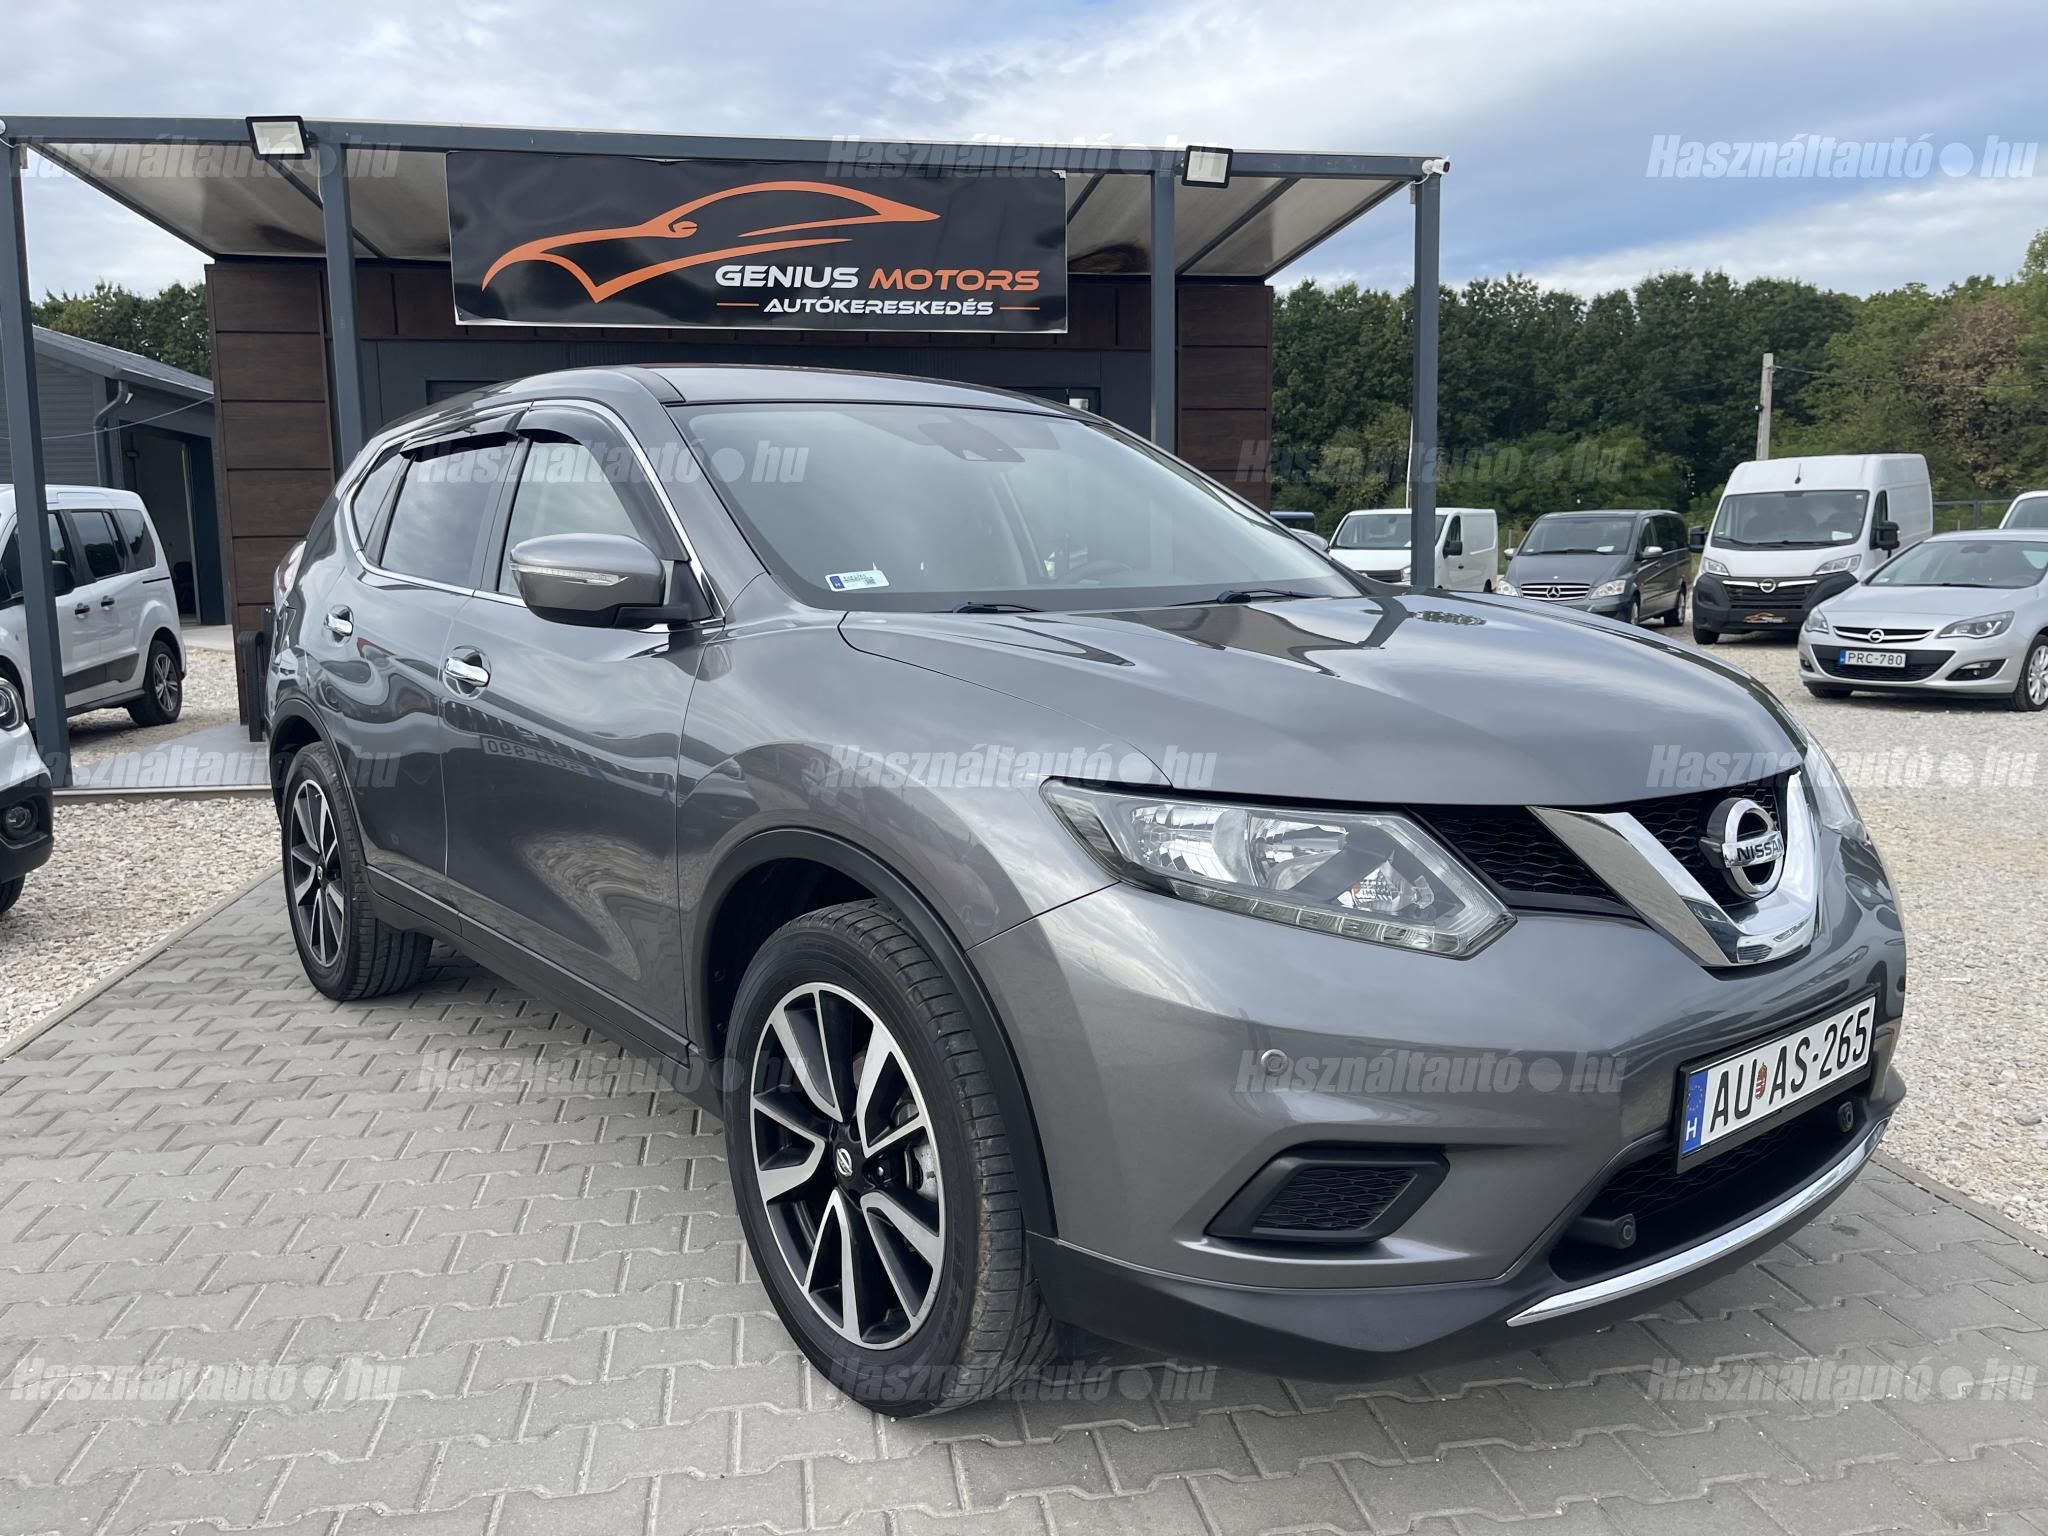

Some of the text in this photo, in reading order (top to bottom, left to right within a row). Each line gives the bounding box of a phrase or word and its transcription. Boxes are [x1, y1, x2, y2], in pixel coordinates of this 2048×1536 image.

[715, 264, 1041, 291] GENIUS MOTORS
[763, 294, 994, 316] AUTÓKERESKEDÉS
[1847, 652, 1904, 666] PRC-780
[1684, 1117, 1699, 1142] H
